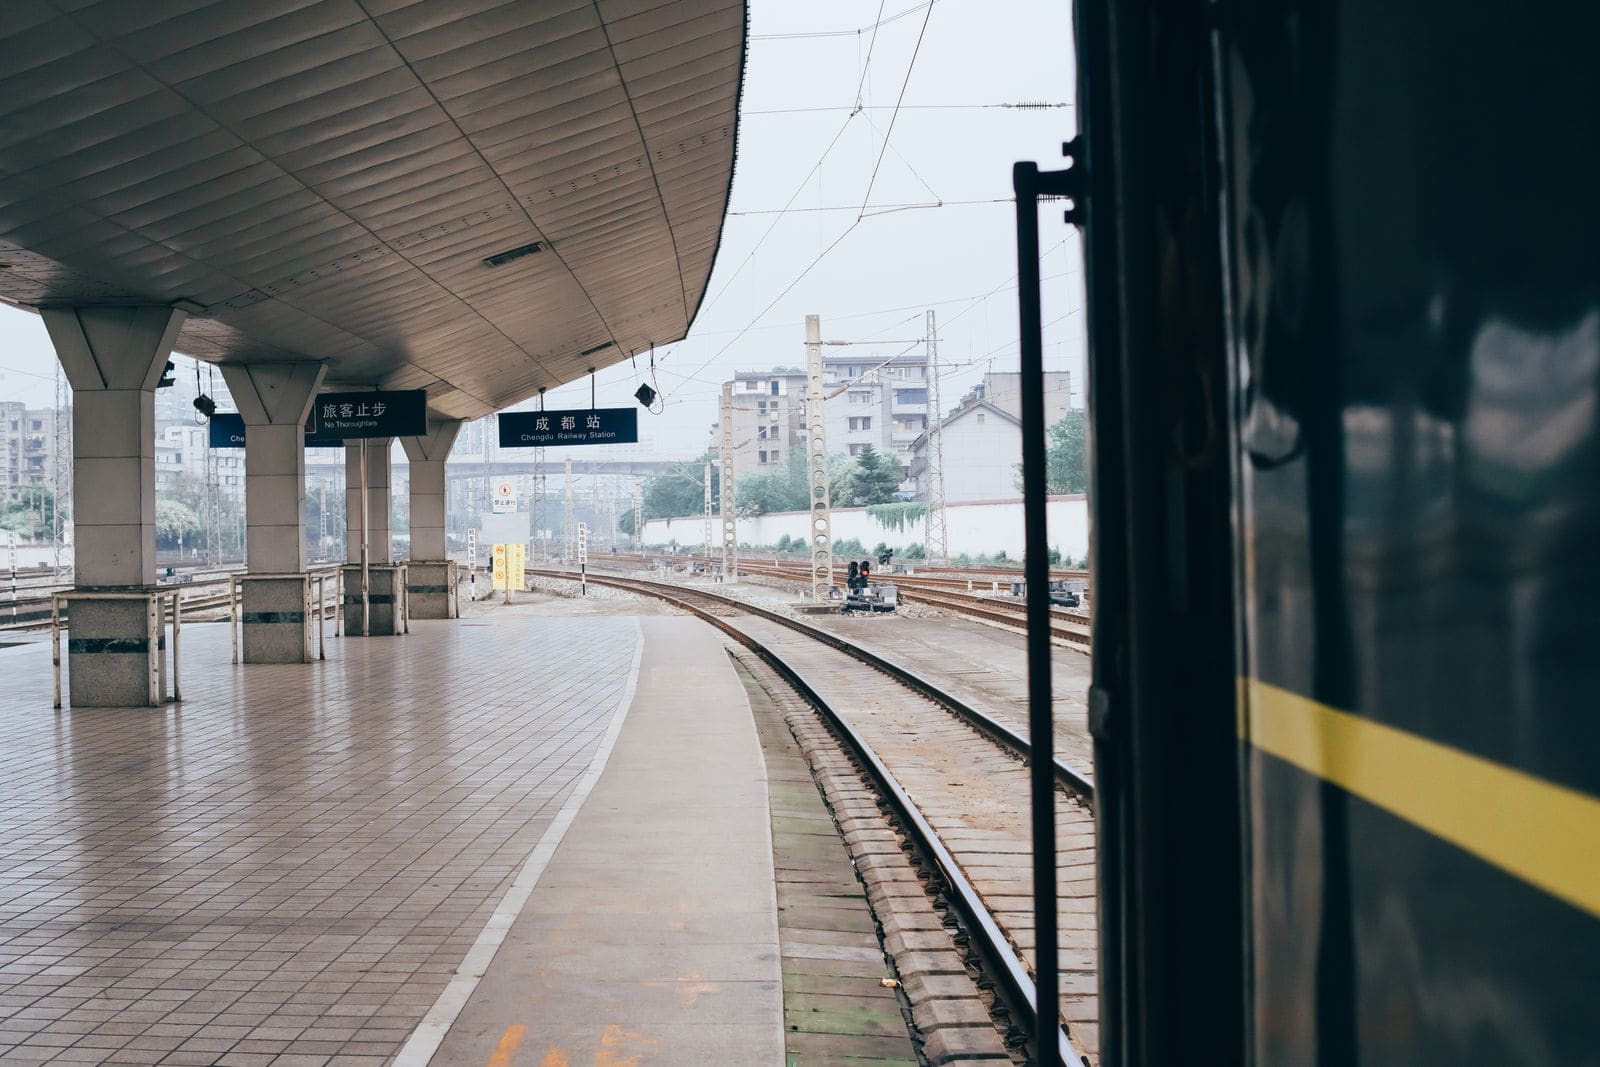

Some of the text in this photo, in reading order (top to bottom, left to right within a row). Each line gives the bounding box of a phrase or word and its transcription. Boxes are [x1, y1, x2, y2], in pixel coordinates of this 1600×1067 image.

[322, 401, 387, 418] 旅客止步
[535, 414, 601, 431] 成都站
[520, 431, 616, 442] Chengdu Railway Station
